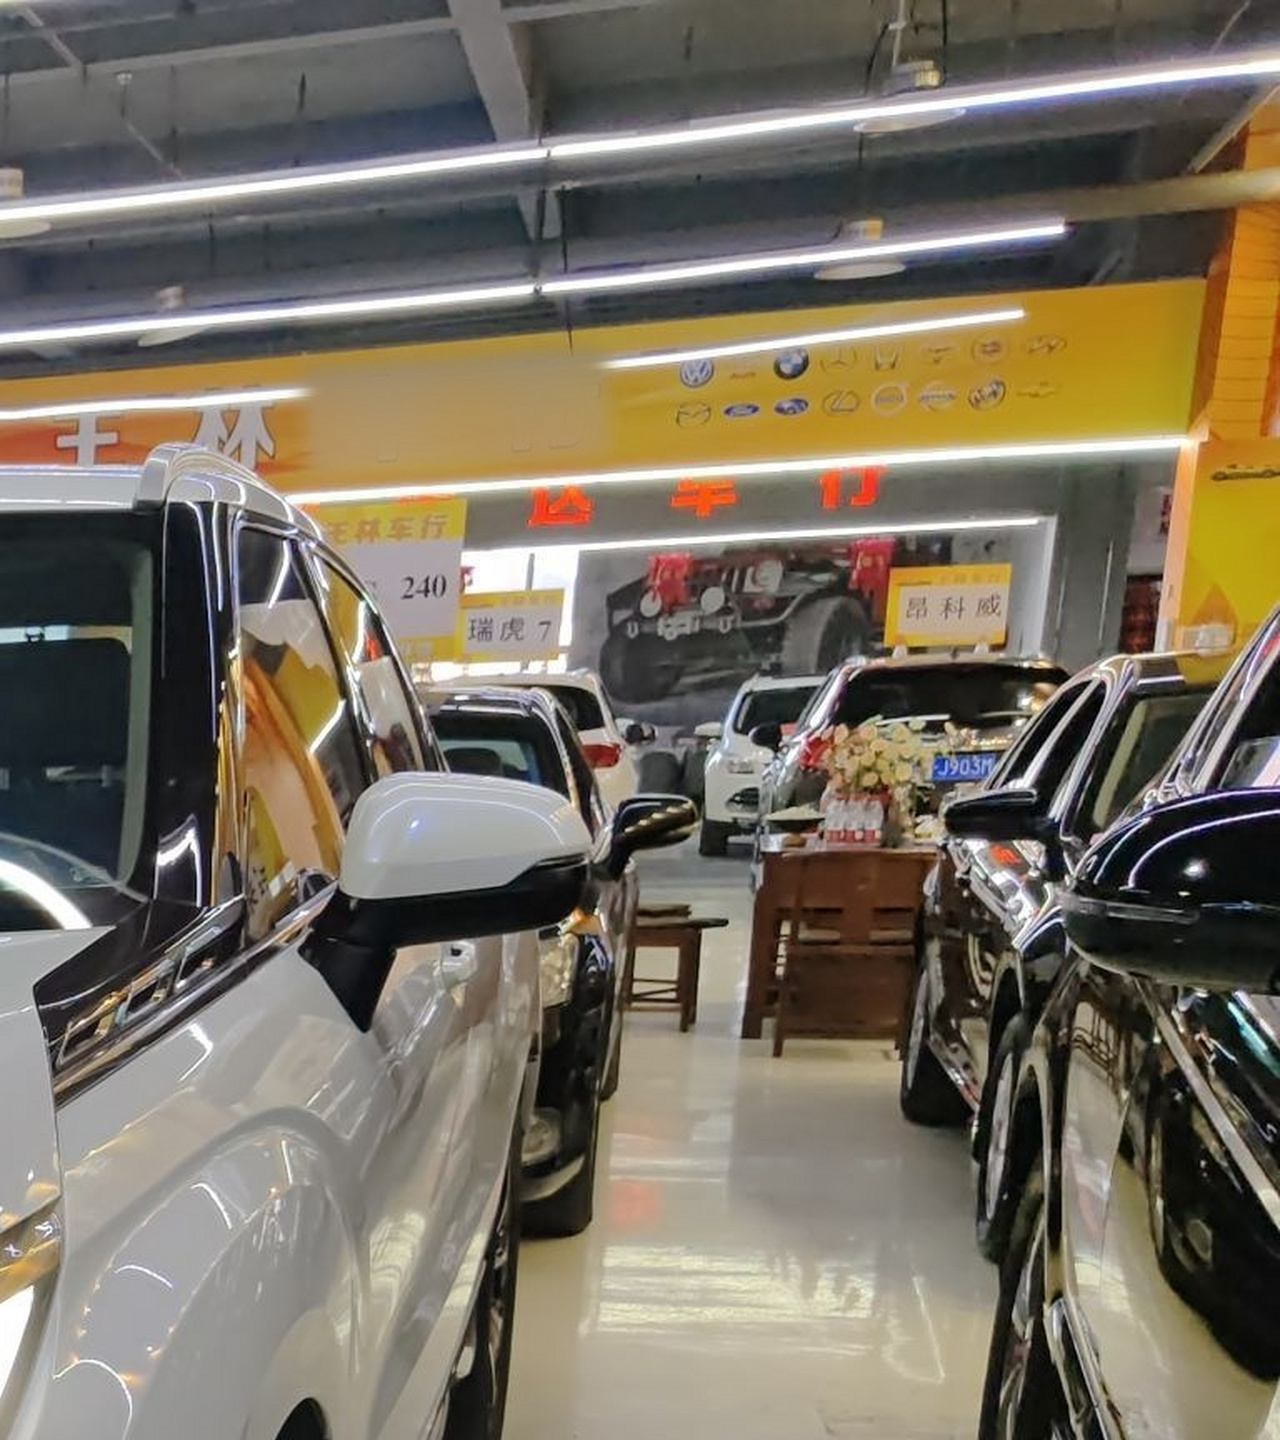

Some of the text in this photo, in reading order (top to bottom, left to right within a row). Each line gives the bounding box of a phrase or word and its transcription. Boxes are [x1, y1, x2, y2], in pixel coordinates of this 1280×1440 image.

[401, 573, 447, 600] 240
[906, 593, 1002, 620] 昂科威
[467, 617, 553, 642] 瑞虎 7
